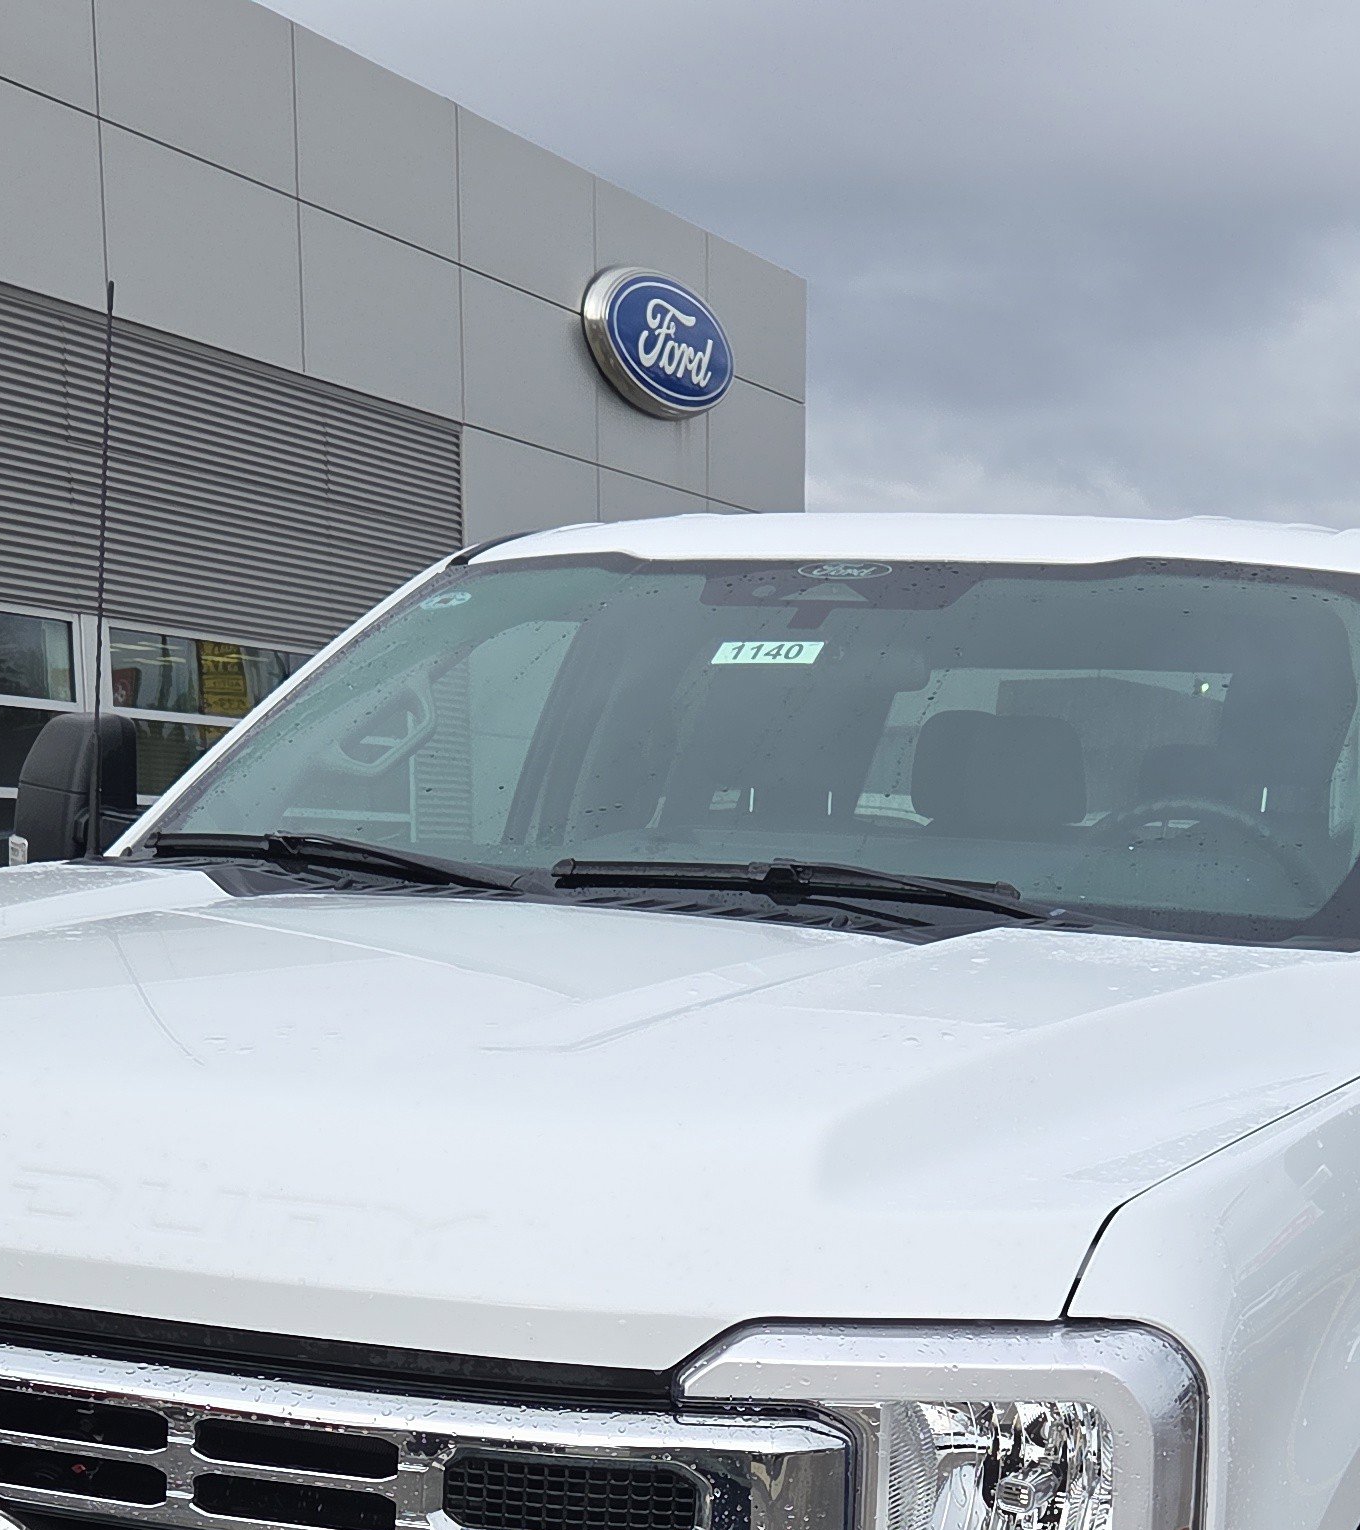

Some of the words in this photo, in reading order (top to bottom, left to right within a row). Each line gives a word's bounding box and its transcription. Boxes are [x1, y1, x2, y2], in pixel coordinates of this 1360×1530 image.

[638, 298, 714, 388] Ford
[731, 643, 804, 661] 1140
[8, 1162, 492, 1264] DUTY
